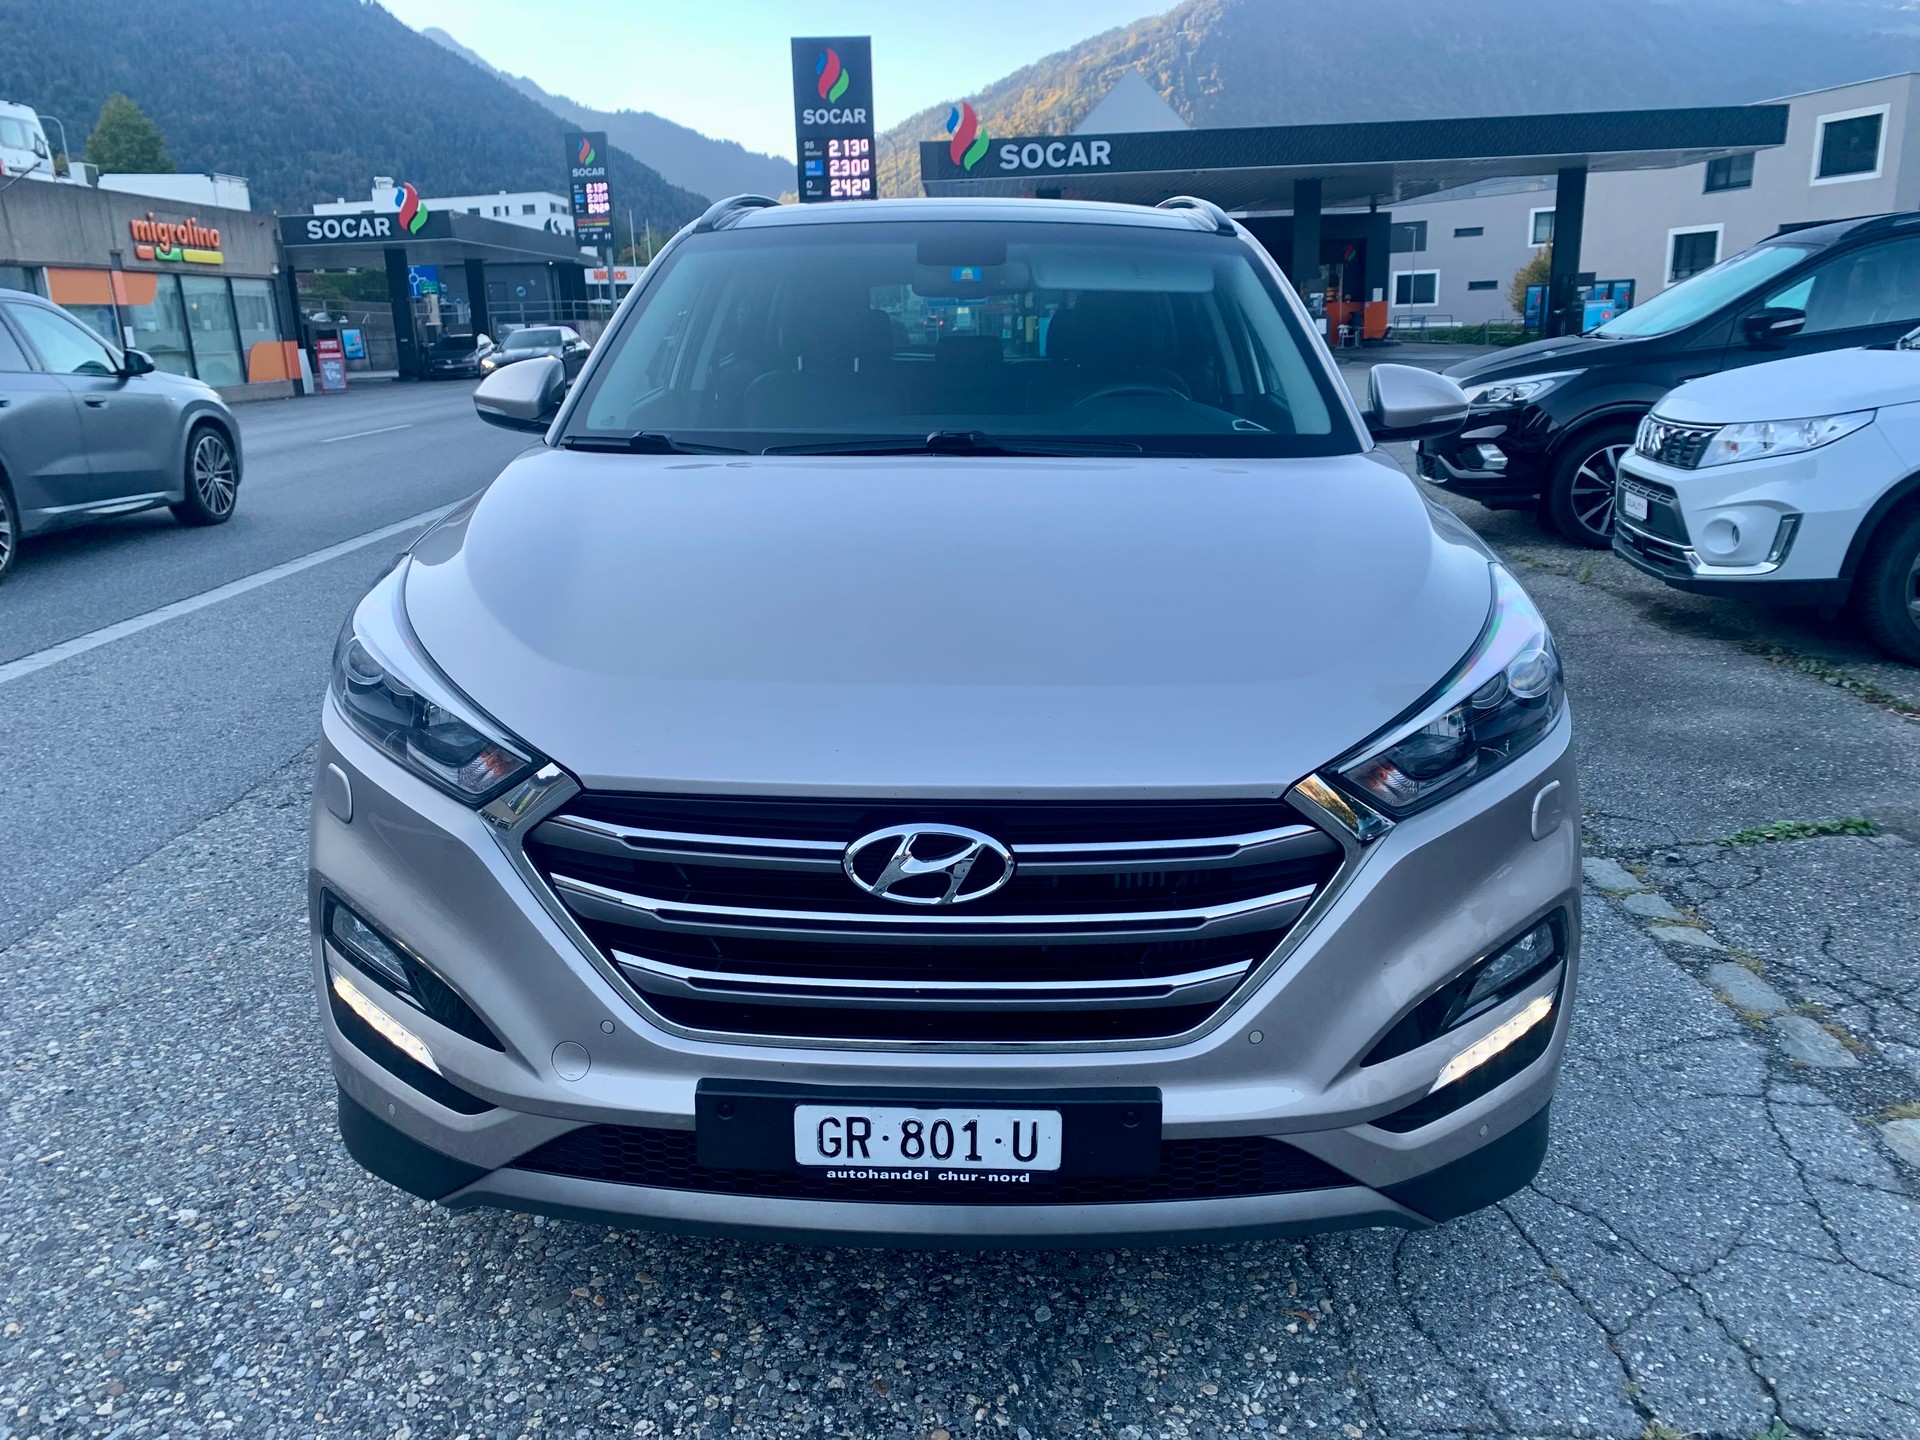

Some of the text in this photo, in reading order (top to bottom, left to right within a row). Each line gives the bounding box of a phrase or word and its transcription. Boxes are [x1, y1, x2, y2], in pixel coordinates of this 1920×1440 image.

[803, 108, 866, 125] SOCAR
[804, 141, 814, 149] 95
[1000, 140, 1111, 170] SOCAR
[572, 167, 605, 177] SOCAR
[806, 181, 813, 189] D
[131, 212, 221, 252] migrolino
[306, 217, 391, 240] SOCAR
[594, 270, 627, 280] MIGOS
[827, 1169, 1030, 1183] autohandel chur-nord
